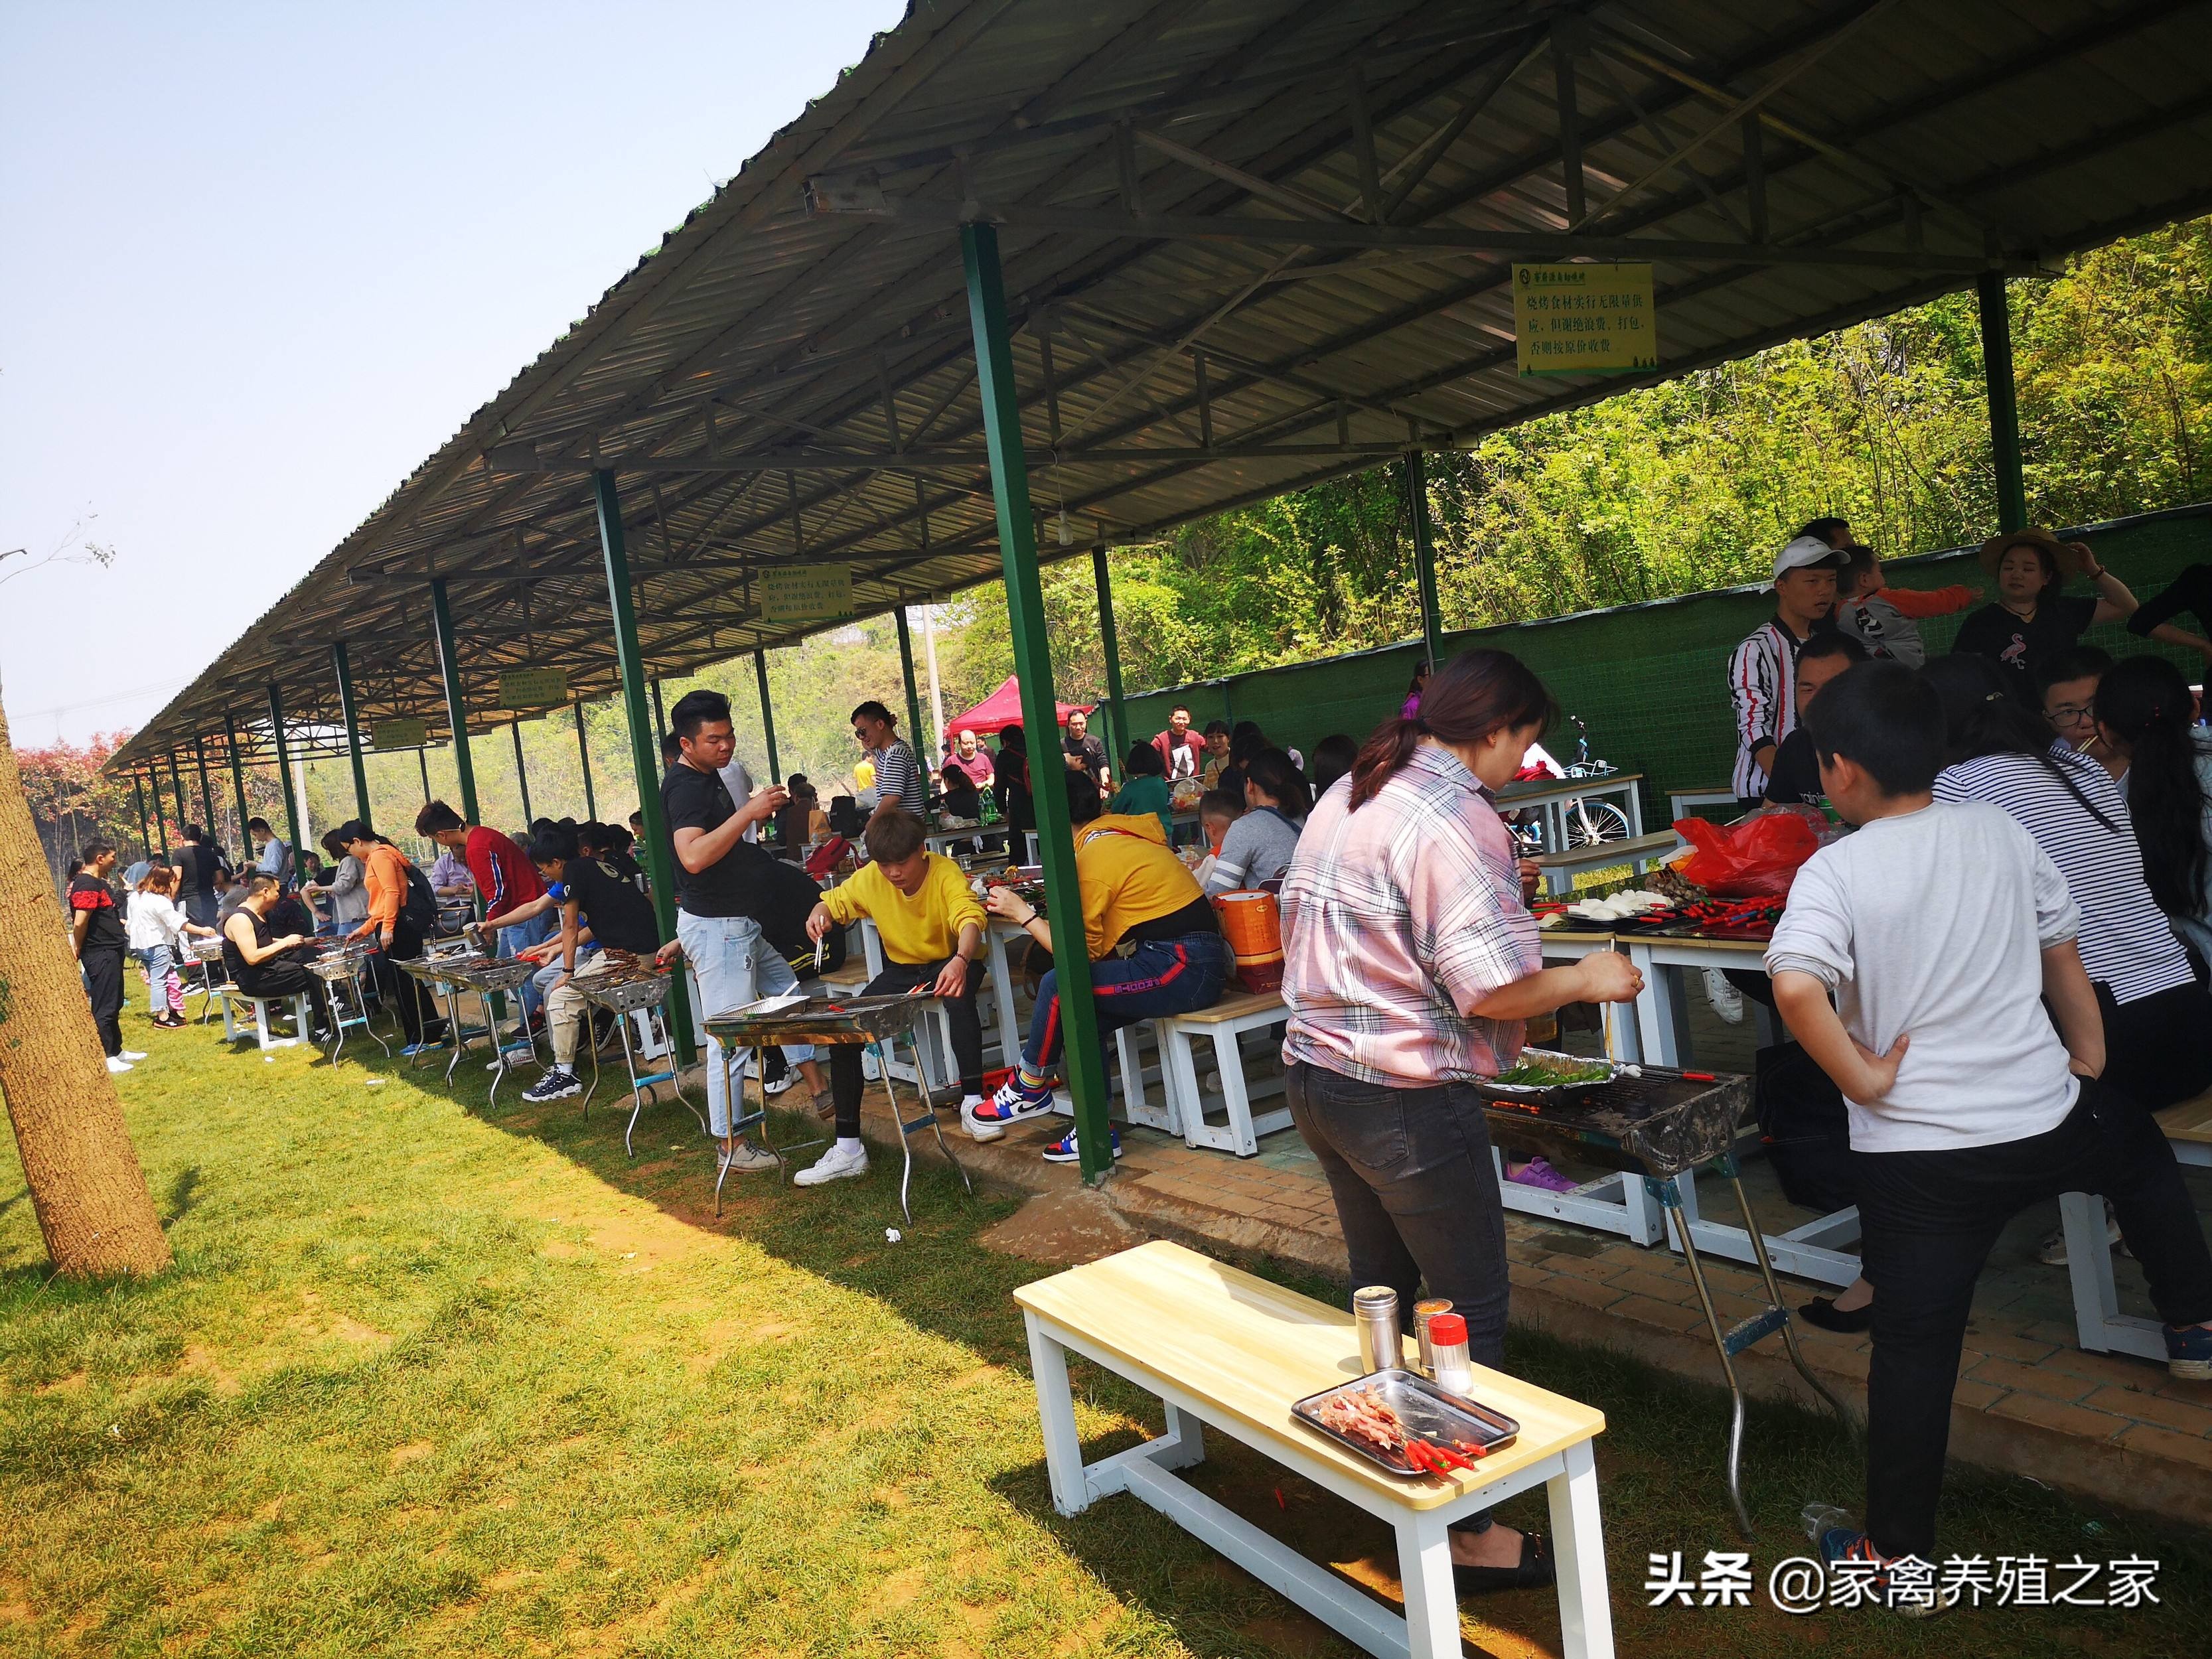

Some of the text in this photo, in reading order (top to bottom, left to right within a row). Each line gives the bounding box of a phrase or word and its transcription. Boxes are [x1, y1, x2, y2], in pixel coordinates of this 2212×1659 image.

[1526, 294, 1643, 311] 烧烤食材实行无限量供
[1530, 339, 1611, 356] 否则按原价收费
